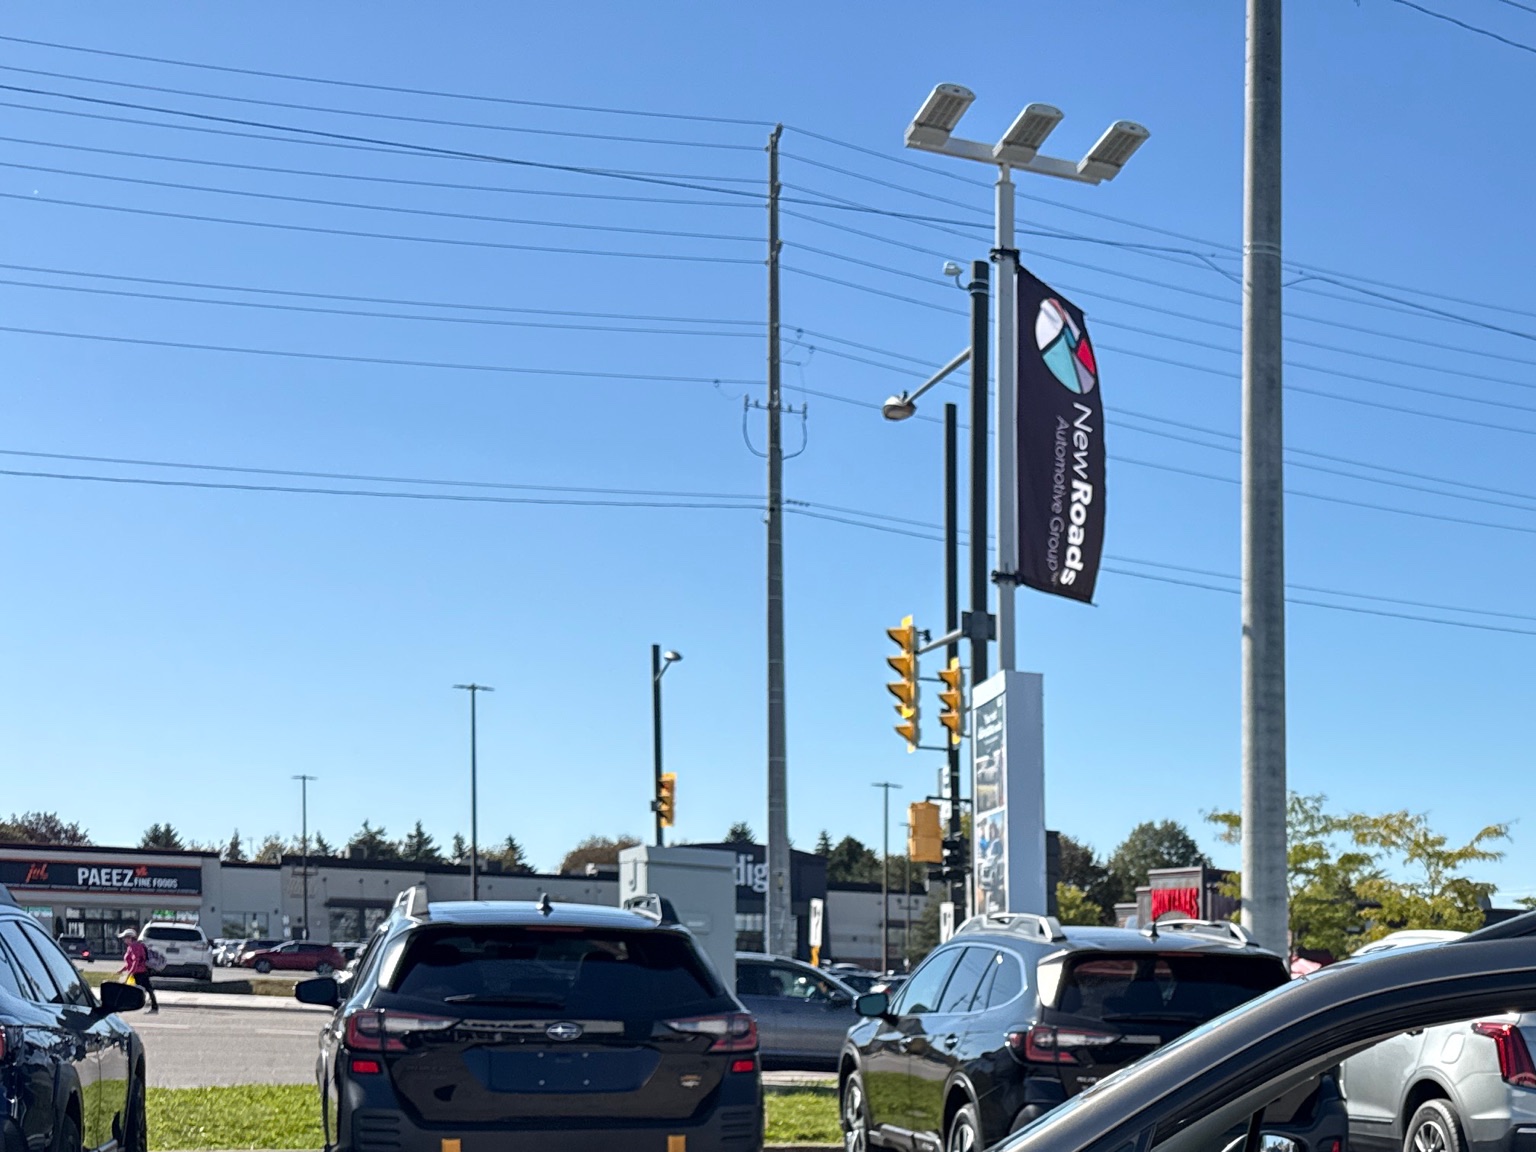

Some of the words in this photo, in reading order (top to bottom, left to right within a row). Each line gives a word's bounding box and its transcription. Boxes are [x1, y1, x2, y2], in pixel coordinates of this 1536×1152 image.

[1051, 414, 1070, 514] Automotive
[77, 867, 134, 887] PAEEZ
[134, 877, 151, 888] FINE
[152, 877, 178, 889] FOODS
